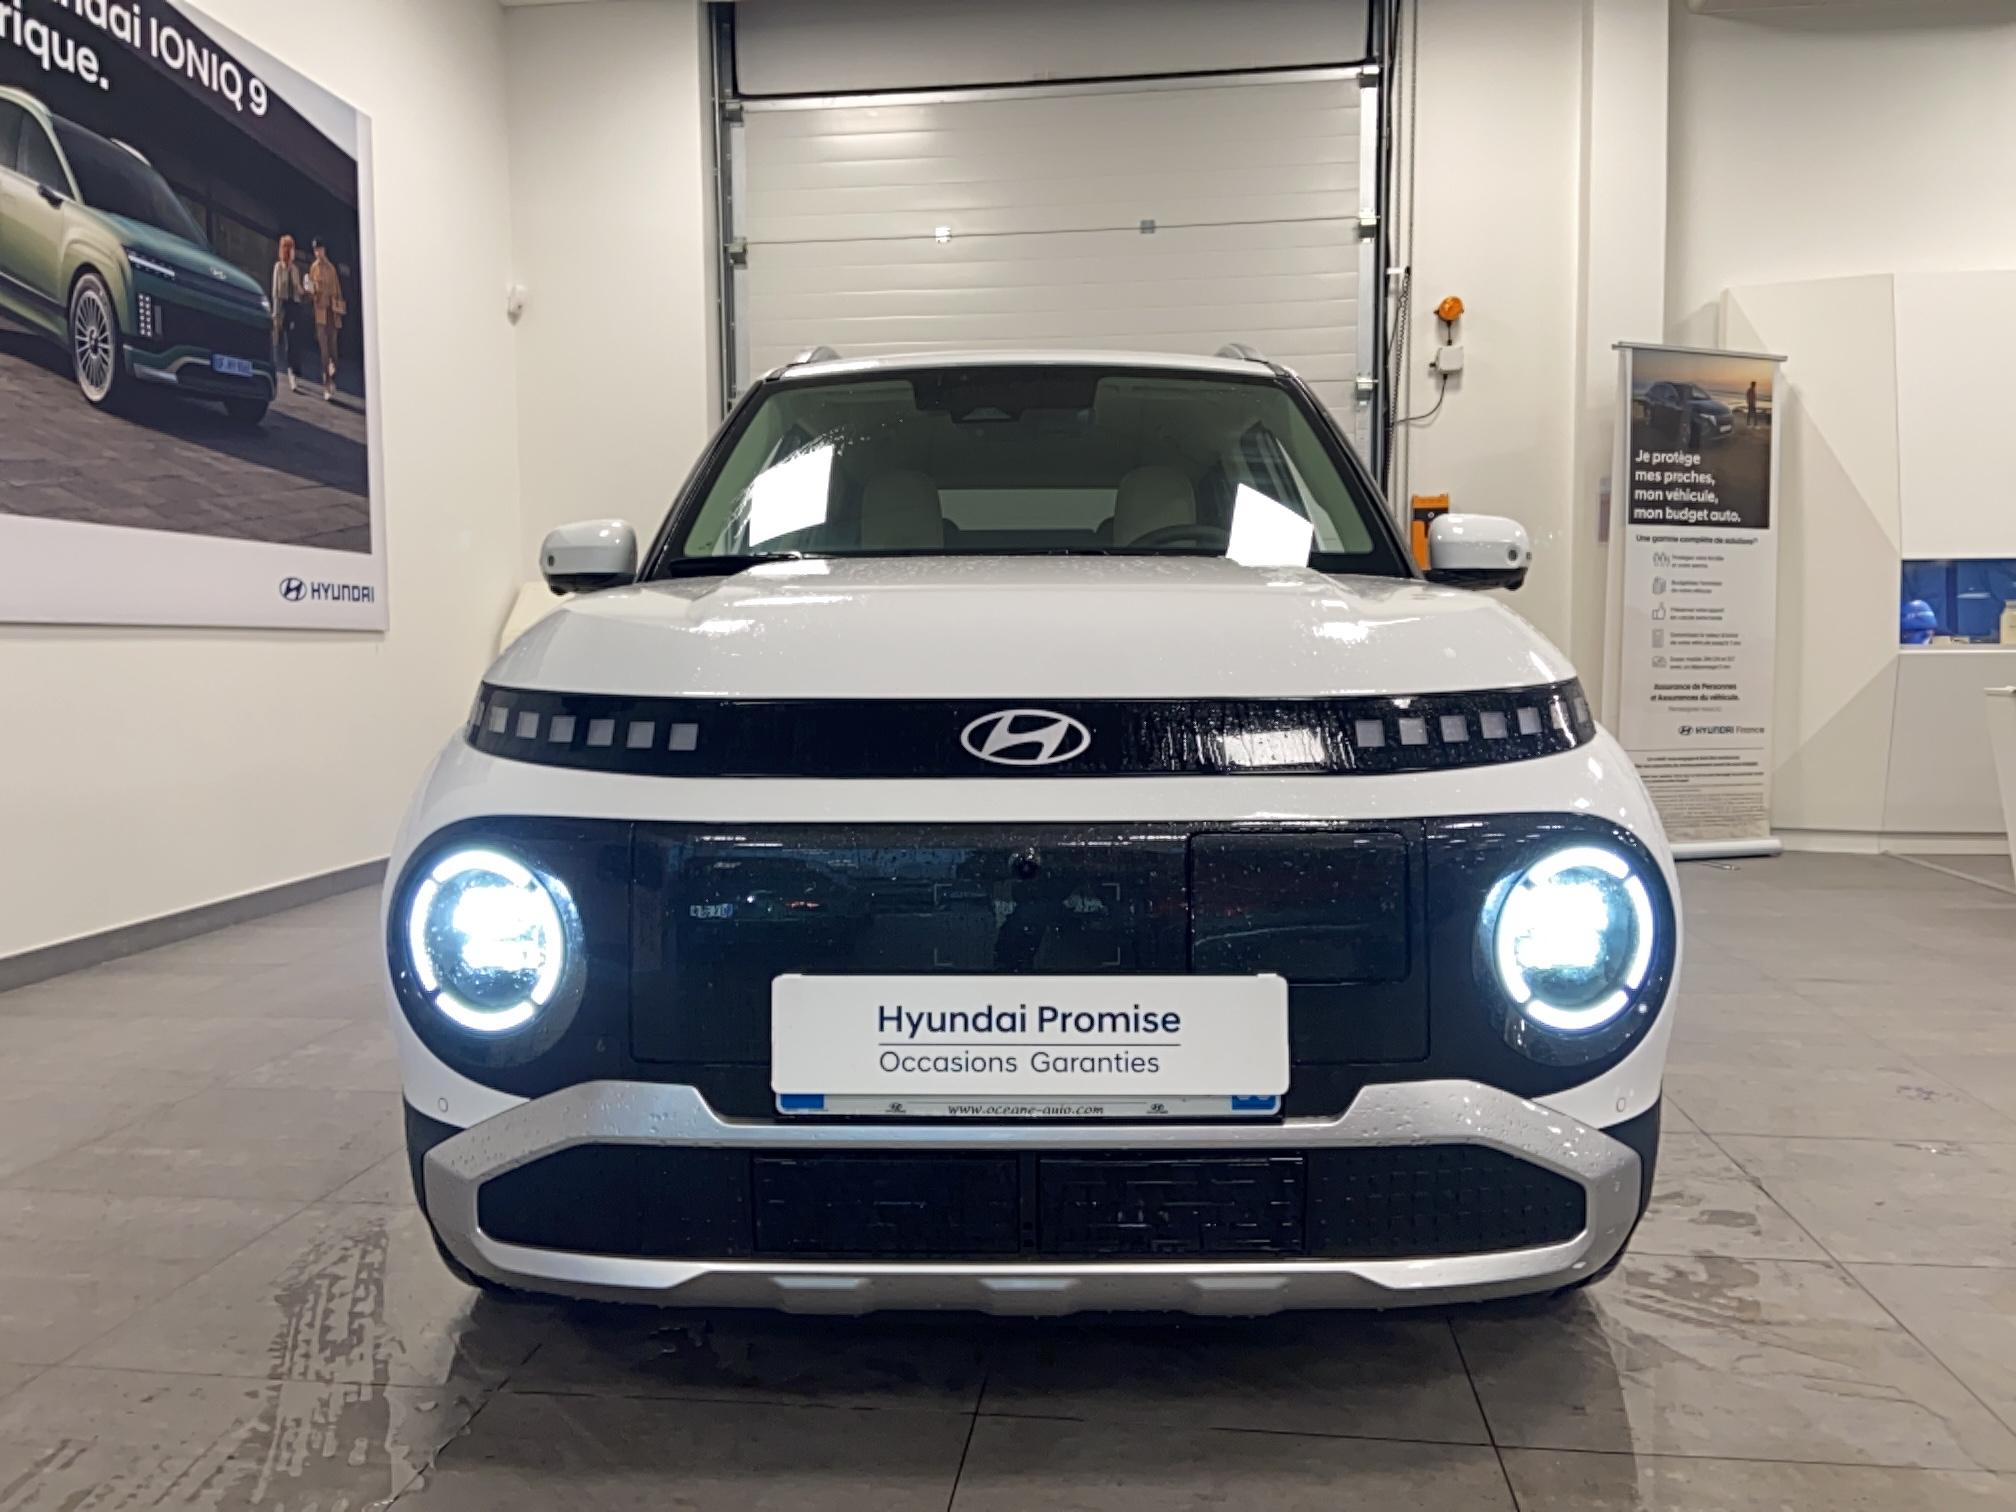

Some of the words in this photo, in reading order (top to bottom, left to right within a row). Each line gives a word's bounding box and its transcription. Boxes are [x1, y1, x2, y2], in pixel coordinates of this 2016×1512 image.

[150, 17, 243, 112] IONIQ
[249, 77, 268, 117] 9
[1635, 450, 1650, 464] Je
[1652, 450, 1701, 467] protège
[1635, 471, 1661, 482] mes
[1664, 471, 1716, 486] proches,
[1635, 489, 1663, 501] mon
[1666, 488, 1719, 504] véhicule,
[1633, 508, 1663, 519] mon
[1665, 507, 1708, 523] budget
[1710, 509, 1741, 522] auto.
[311, 582, 375, 602] HYUNDAI
[1696, 726, 1734, 734] HYUNDAI
[879, 1004, 1027, 1039] Hyundai
[1038, 1004, 1182, 1033] Promise
[880, 1050, 1018, 1073] Occasions
[1030, 1050, 1160, 1073] Garanties
